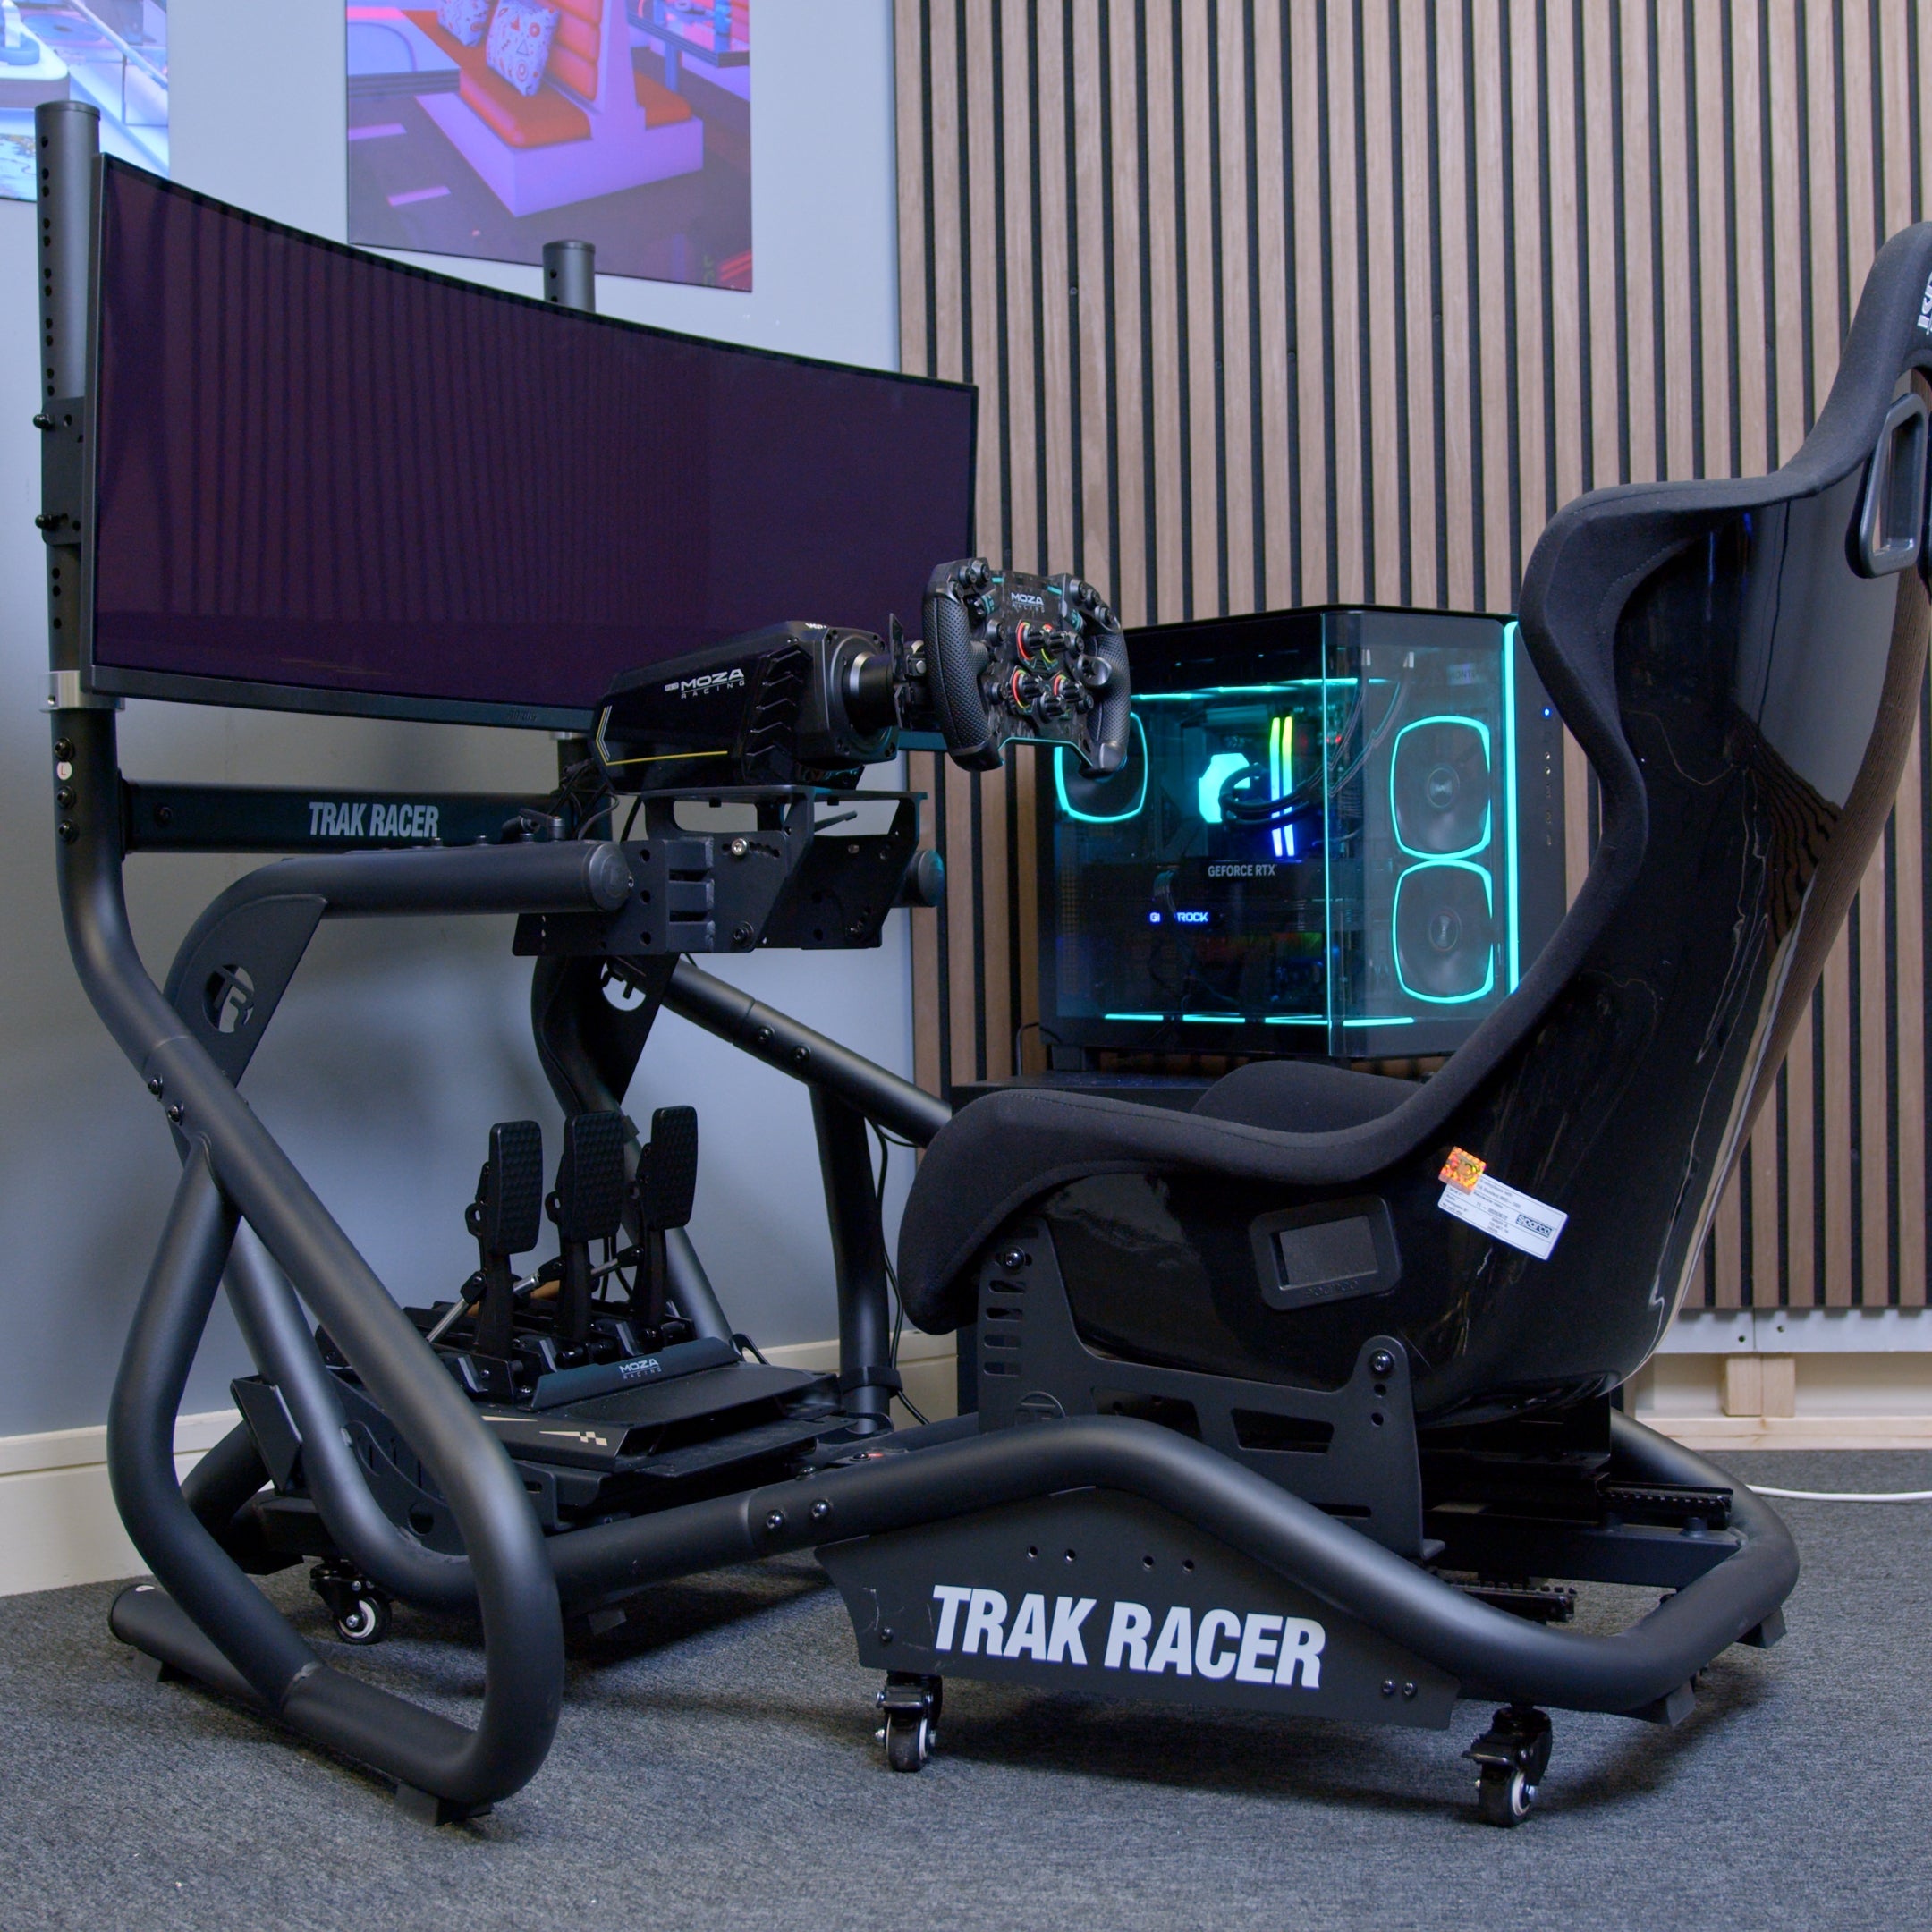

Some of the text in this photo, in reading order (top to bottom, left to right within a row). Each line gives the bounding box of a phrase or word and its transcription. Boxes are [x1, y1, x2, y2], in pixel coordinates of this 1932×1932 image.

[1011, 592, 1044, 606] MOZA
[681, 669, 744, 691] MOZA
[681, 680, 745, 699] RACING
[309, 802, 439, 837] TRAK RACER
[1208, 864, 1275, 877] GEFORCE RTX
[619, 1359, 659, 1373] MOZA
[933, 1585, 1326, 1689] TRAK RACER
